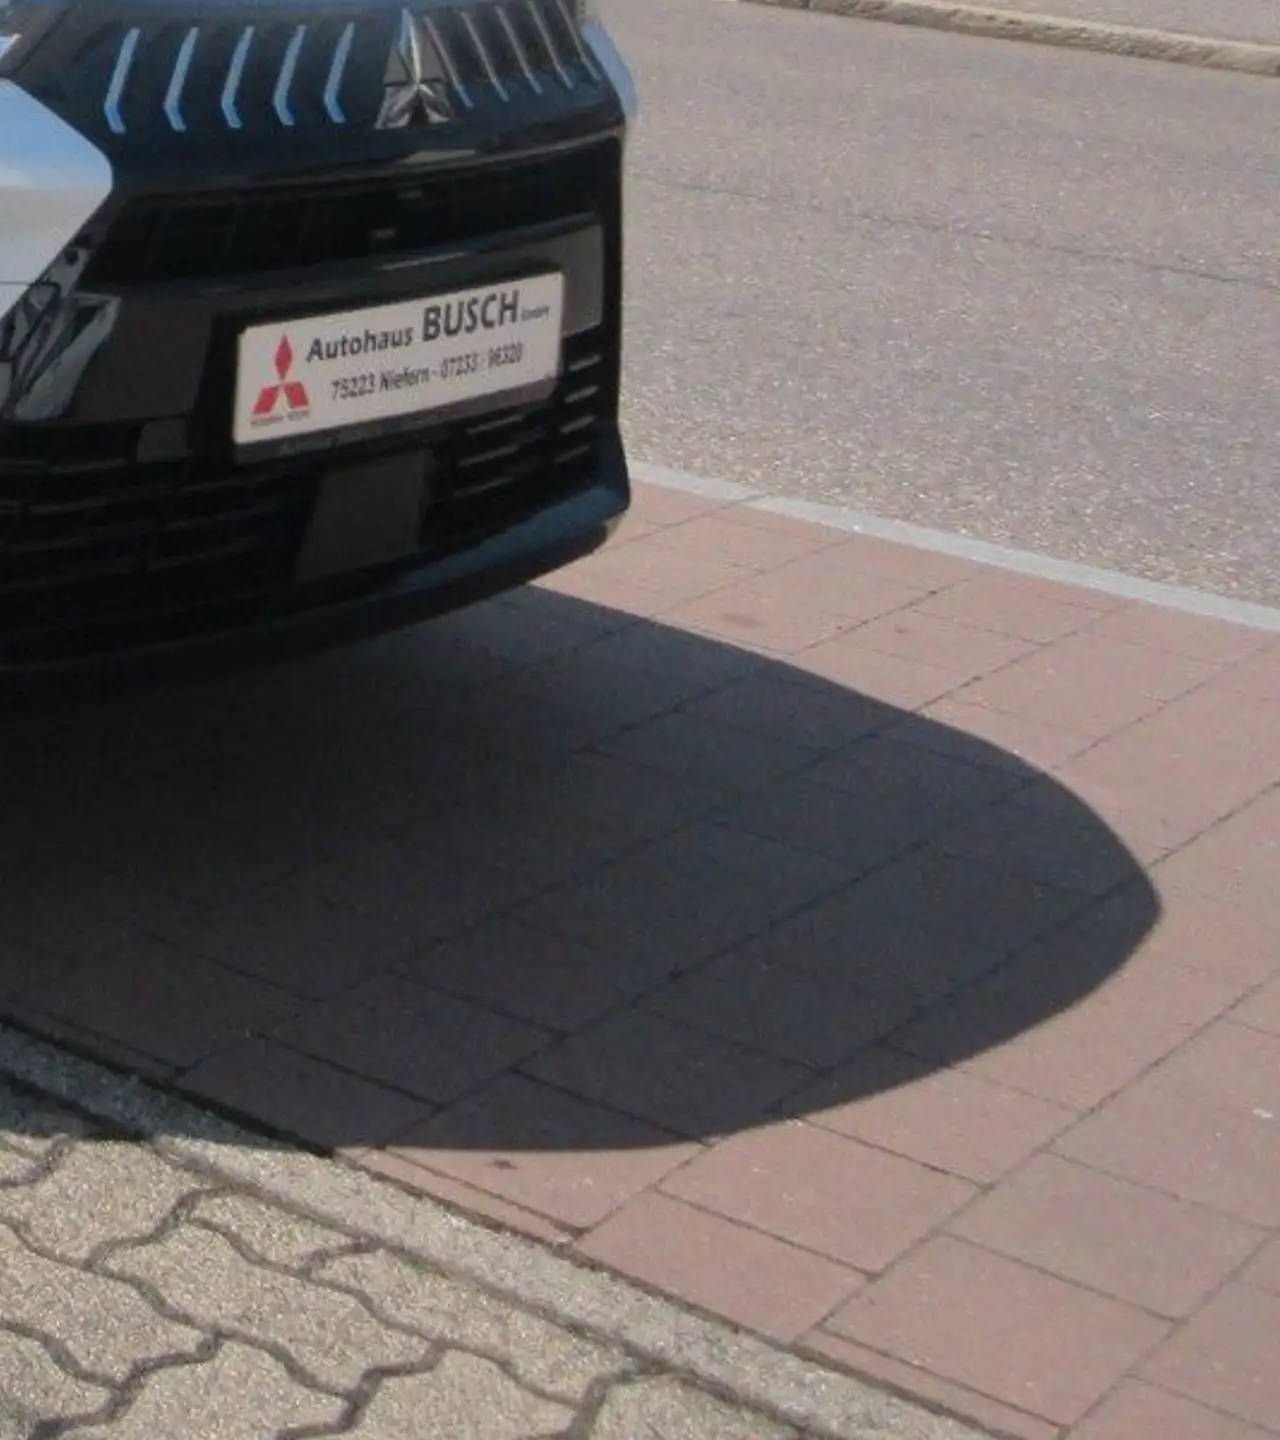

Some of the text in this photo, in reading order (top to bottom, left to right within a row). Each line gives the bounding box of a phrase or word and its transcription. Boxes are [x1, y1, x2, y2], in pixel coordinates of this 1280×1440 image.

[306, 327, 414, 363] Autohaus
[422, 290, 520, 342] BUSCH
[330, 371, 376, 401] 75223
[379, 366, 430, 393] Niefern
